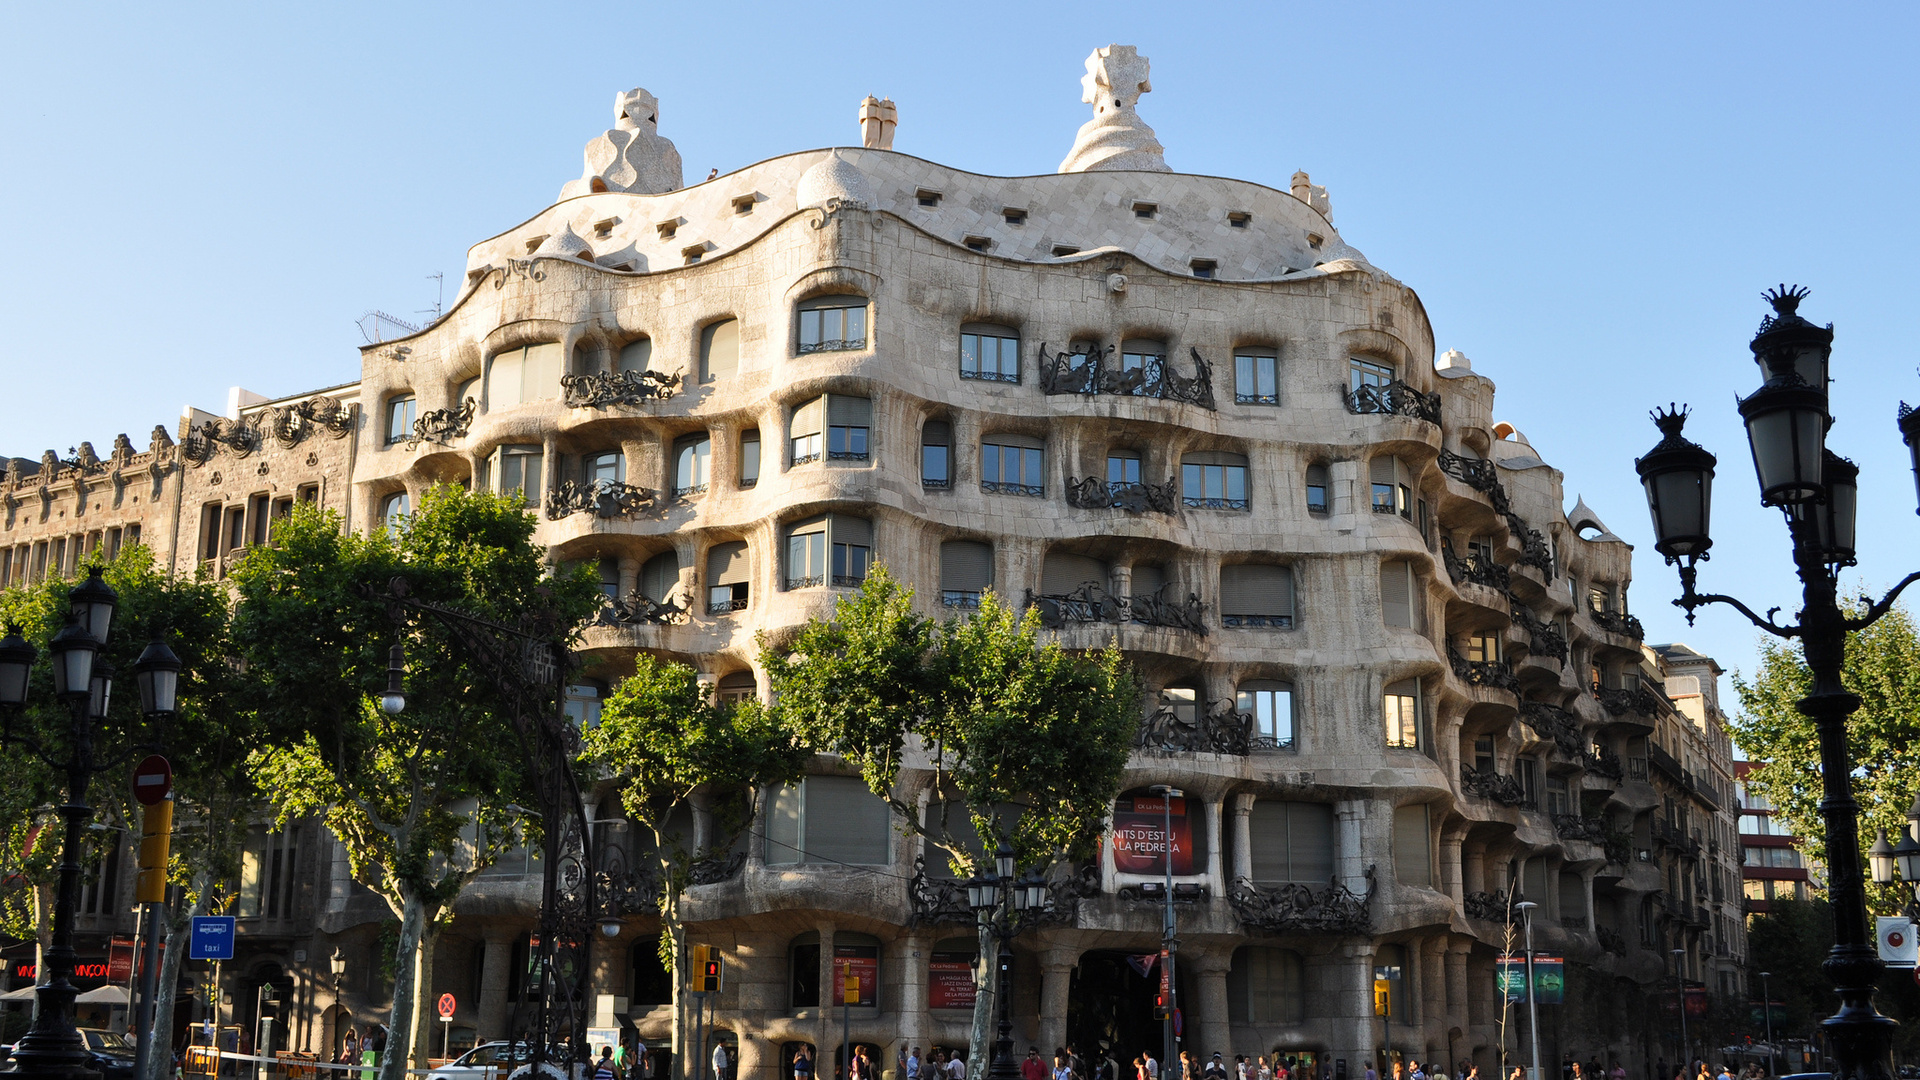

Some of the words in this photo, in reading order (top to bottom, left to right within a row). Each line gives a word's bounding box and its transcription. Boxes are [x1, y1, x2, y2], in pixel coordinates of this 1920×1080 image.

[1113, 829, 1136, 840] NITS
[1138, 830, 1176, 841] D'ESTU
[1119, 841, 1132, 851] LA
[204, 943, 220, 952] taxi
[17, 965, 36, 978] VINÇ
